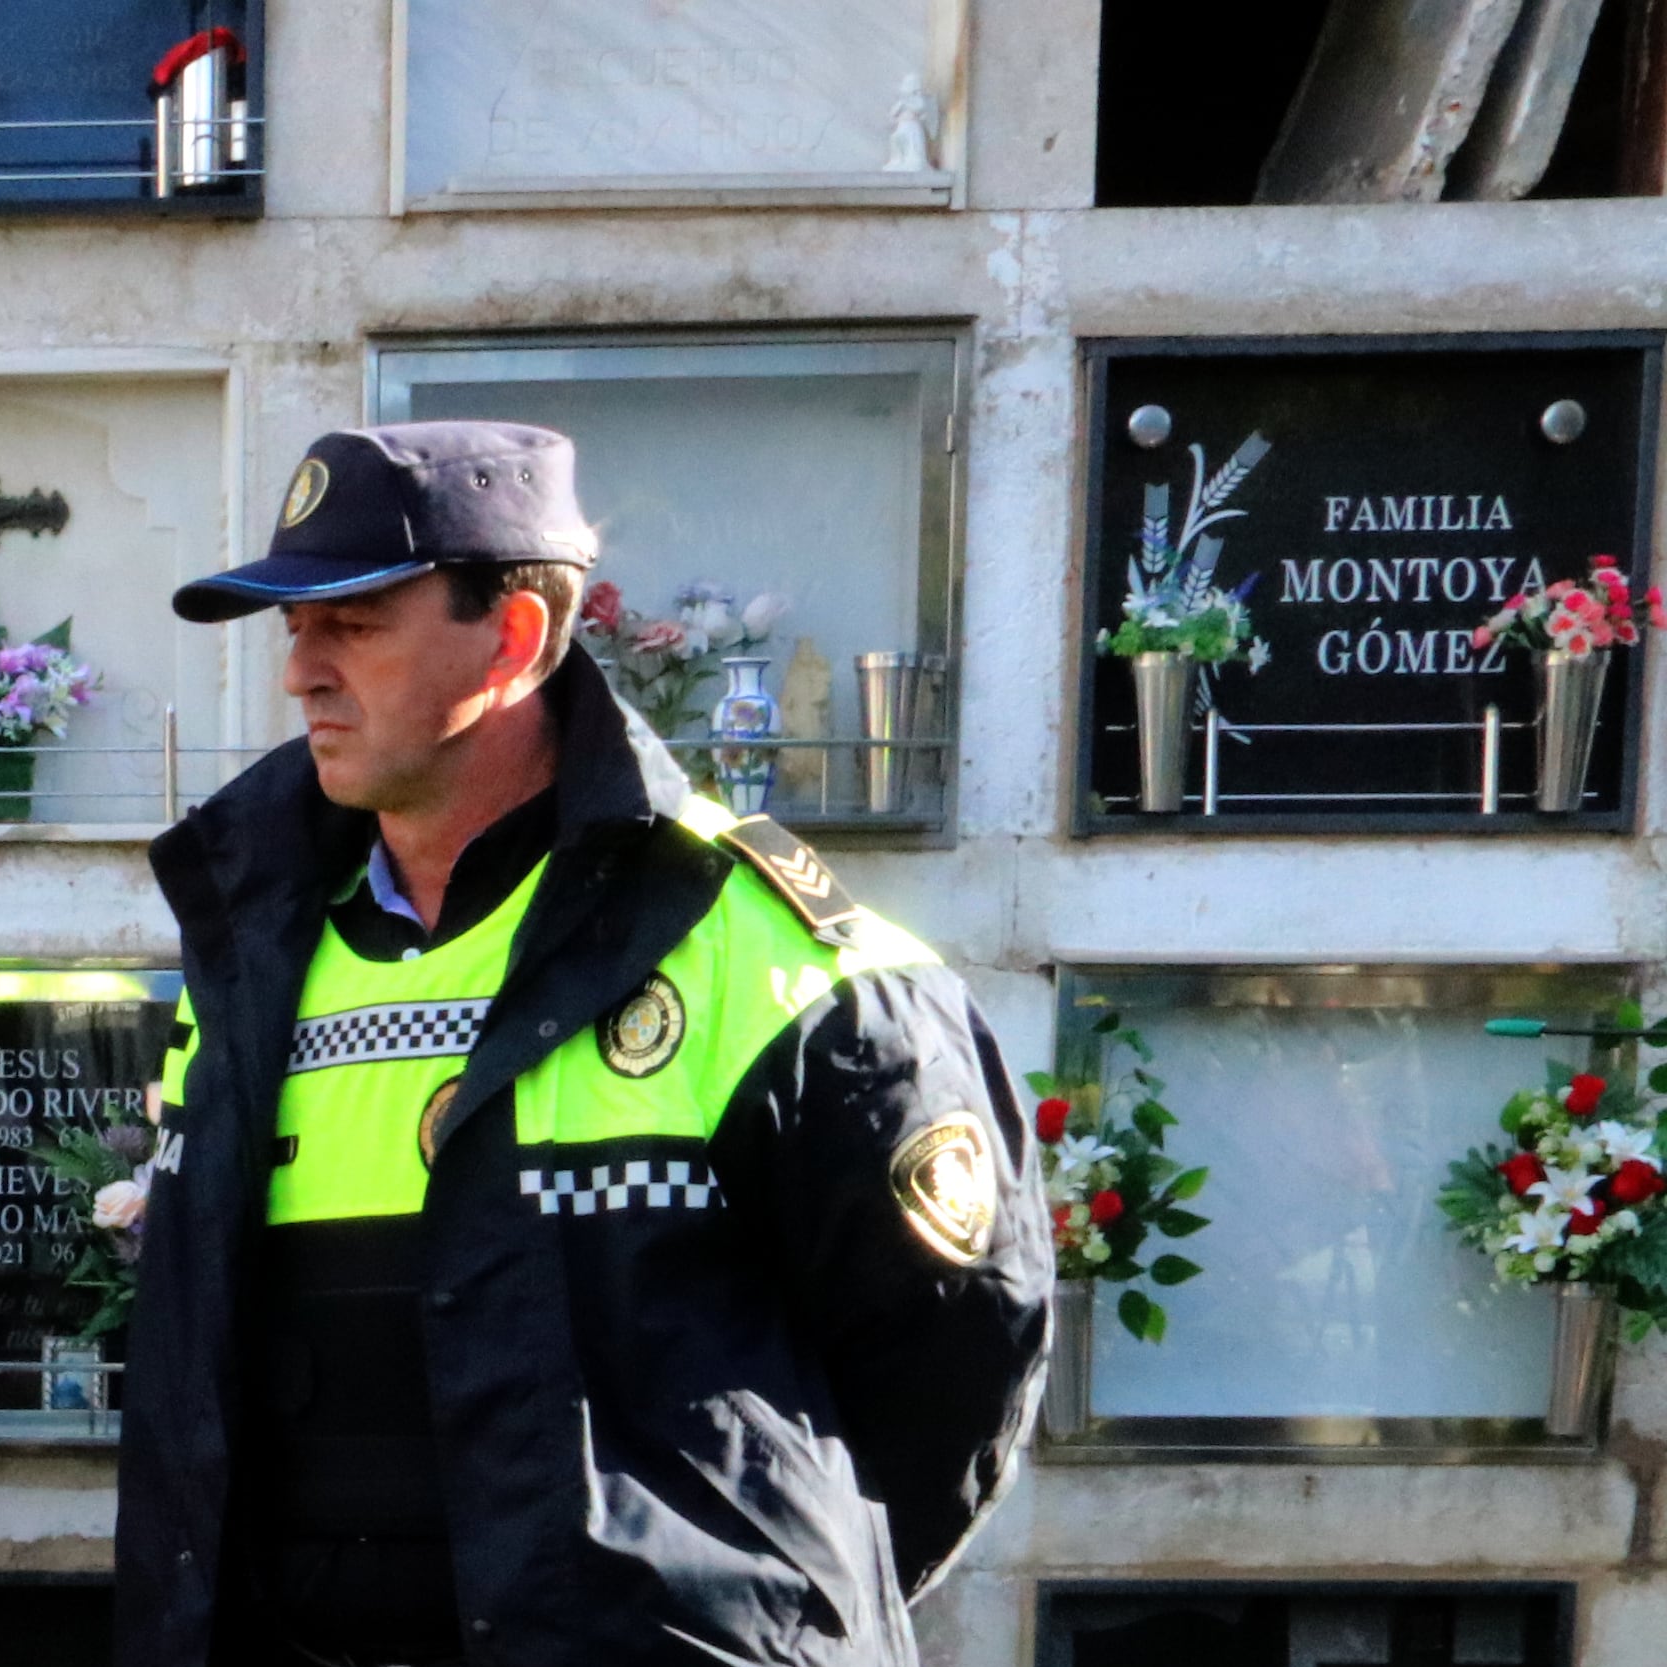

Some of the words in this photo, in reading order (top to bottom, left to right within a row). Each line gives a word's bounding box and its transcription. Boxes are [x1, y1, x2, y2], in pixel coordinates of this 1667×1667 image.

[489, 117, 555, 156] DE
[1323, 494, 1514, 532] FAMILIA
[1279, 555, 1548, 603] MONTOYA
[1317, 616, 1508, 675] GÓMEZ
[42, 1084, 146, 1120] RIVER
